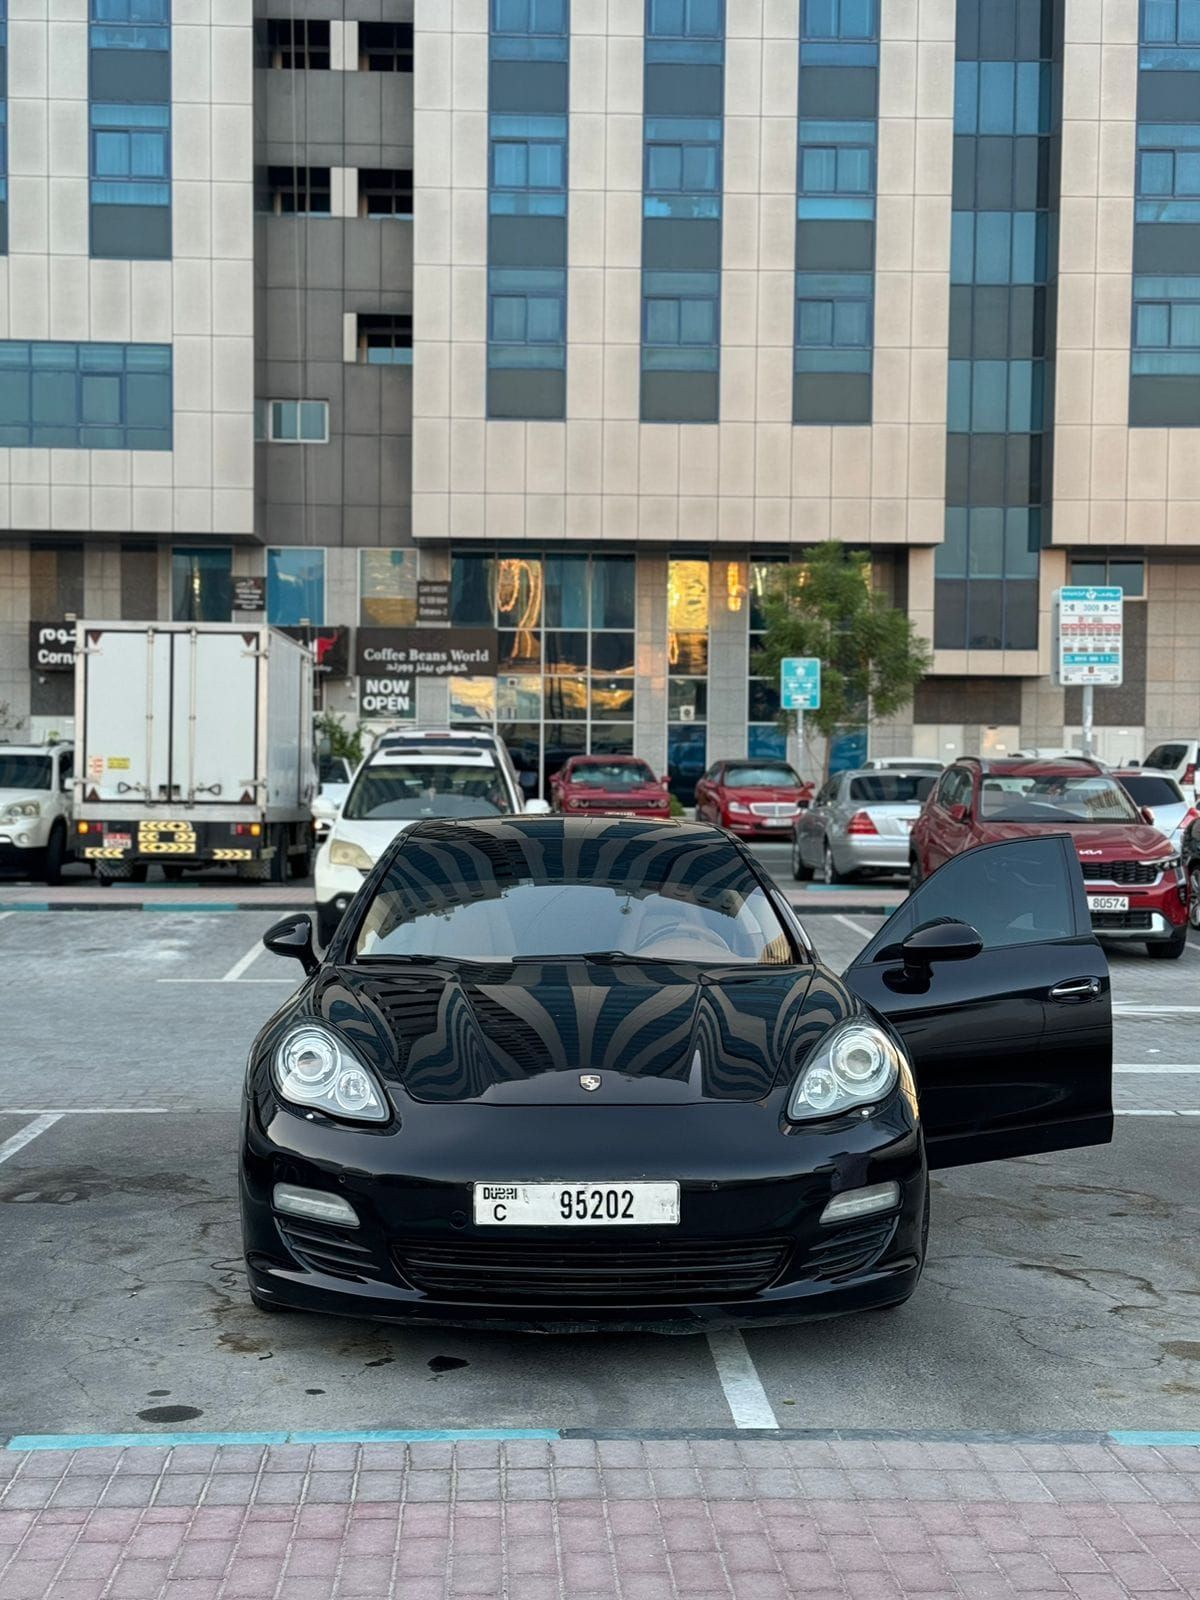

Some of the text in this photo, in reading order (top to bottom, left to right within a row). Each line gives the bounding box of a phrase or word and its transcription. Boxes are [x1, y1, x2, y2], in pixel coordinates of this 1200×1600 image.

[363, 648, 489, 662] Coffee Beans World
[366, 680, 410, 694] NOW
[362, 696, 409, 710] OPEN
[1093, 897, 1126, 909] 80574
[493, 1203, 507, 1221] C
[560, 1190, 635, 1220] 95202
